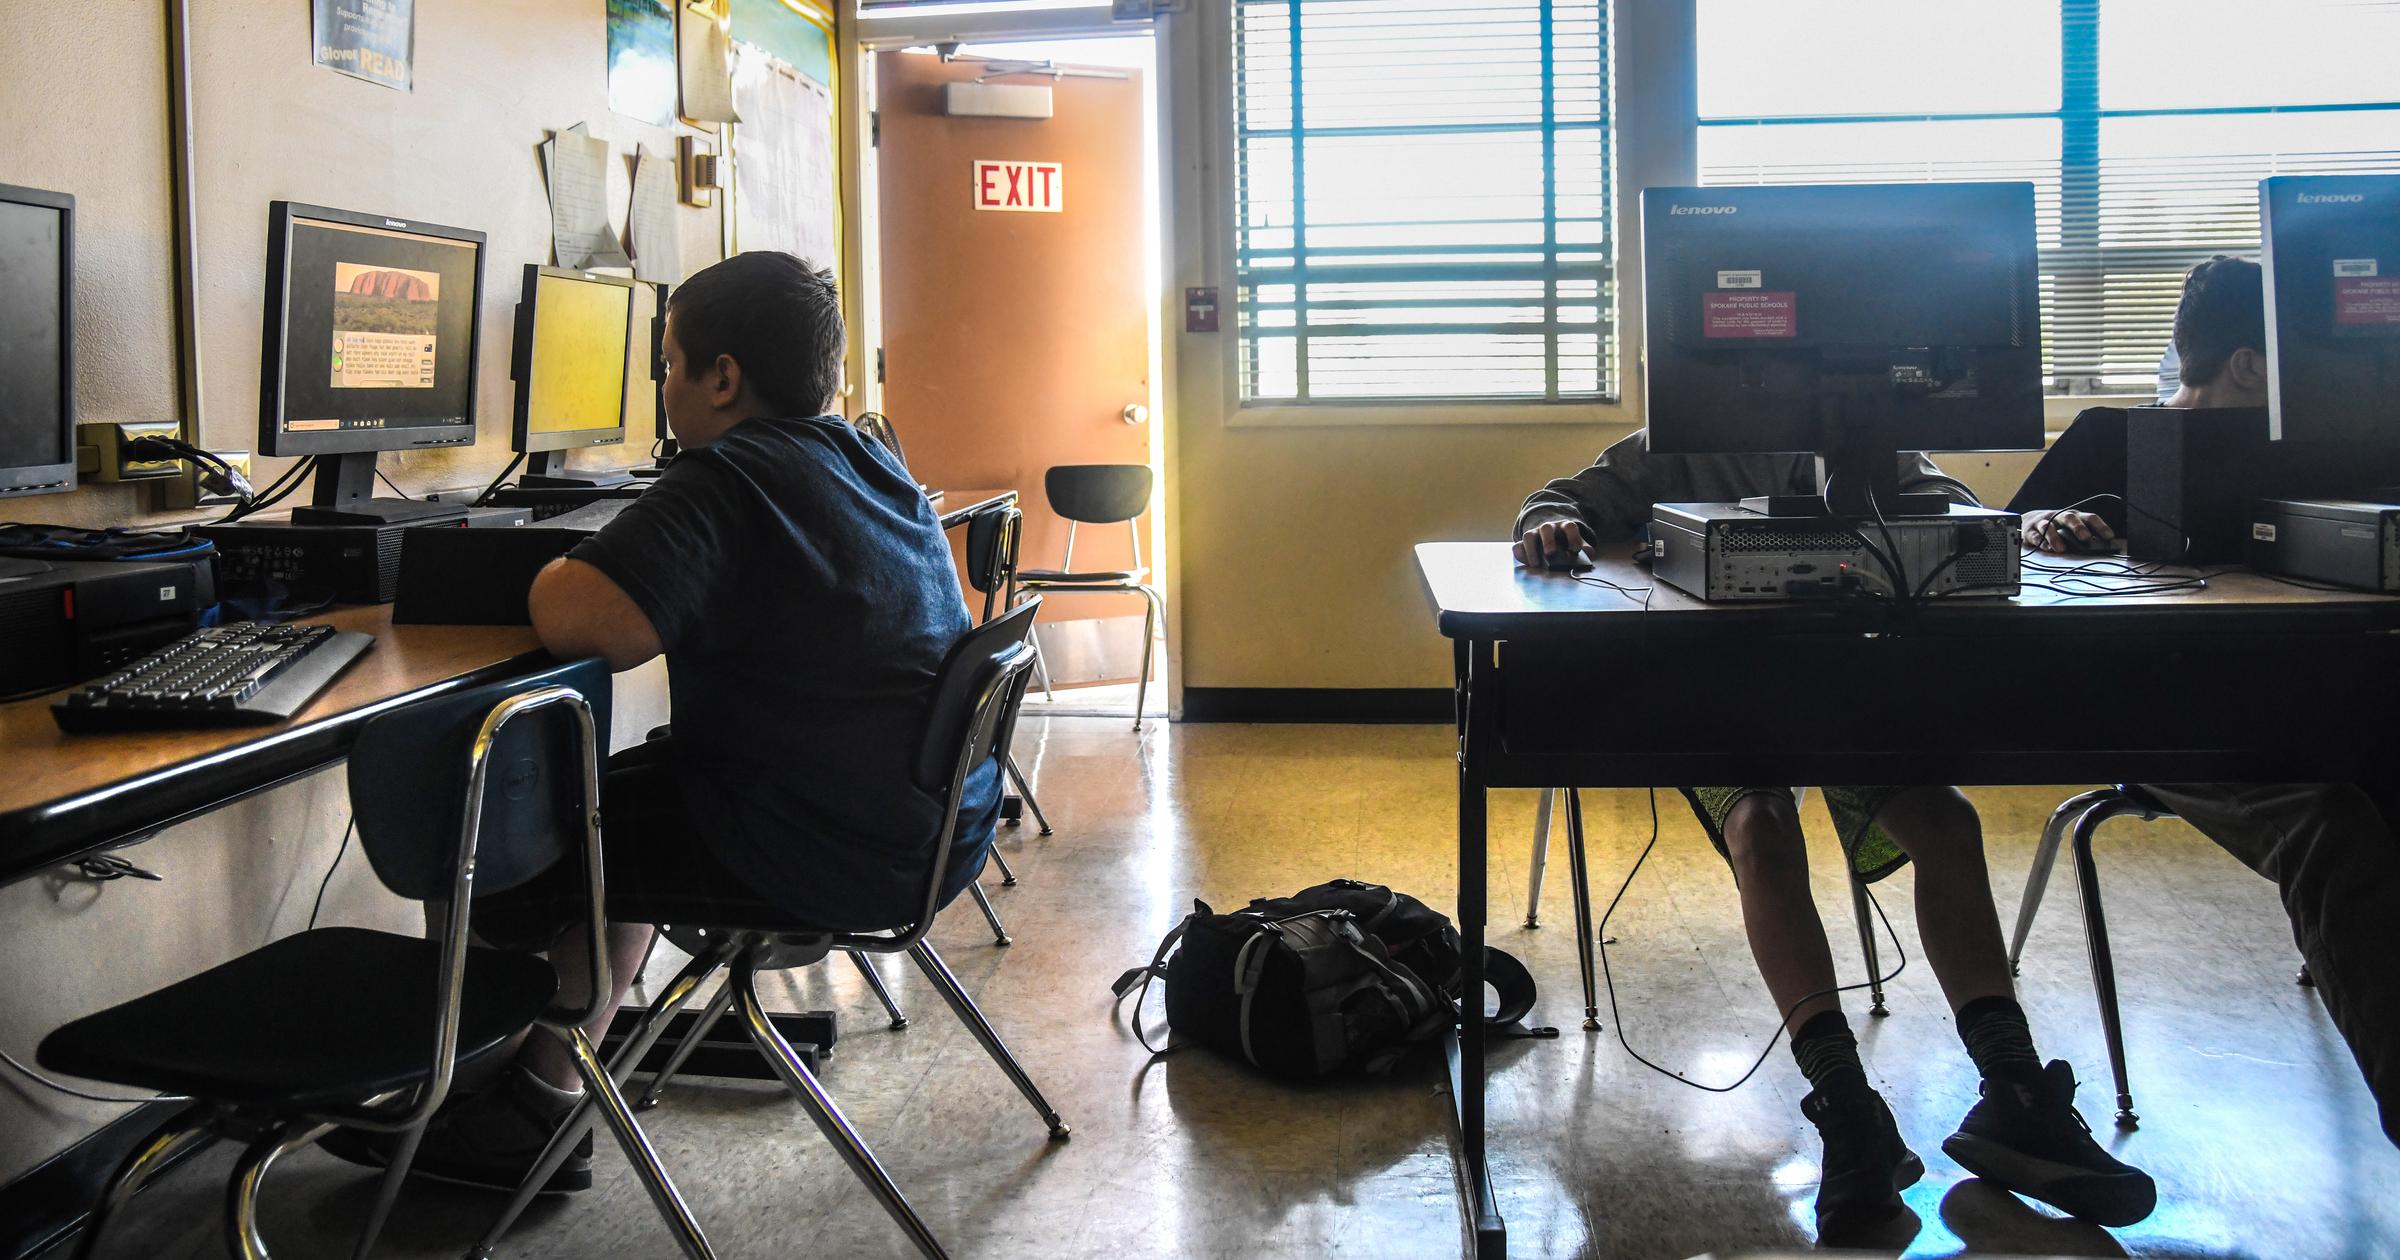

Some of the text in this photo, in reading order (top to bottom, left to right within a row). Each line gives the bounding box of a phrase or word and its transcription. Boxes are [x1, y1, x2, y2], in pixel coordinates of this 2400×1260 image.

[981, 165, 1056, 207] EXIT
[2296, 193, 2364, 204] lenovo
[1670, 204, 1737, 216] lenovo
[385, 218, 407, 229] lenovo
